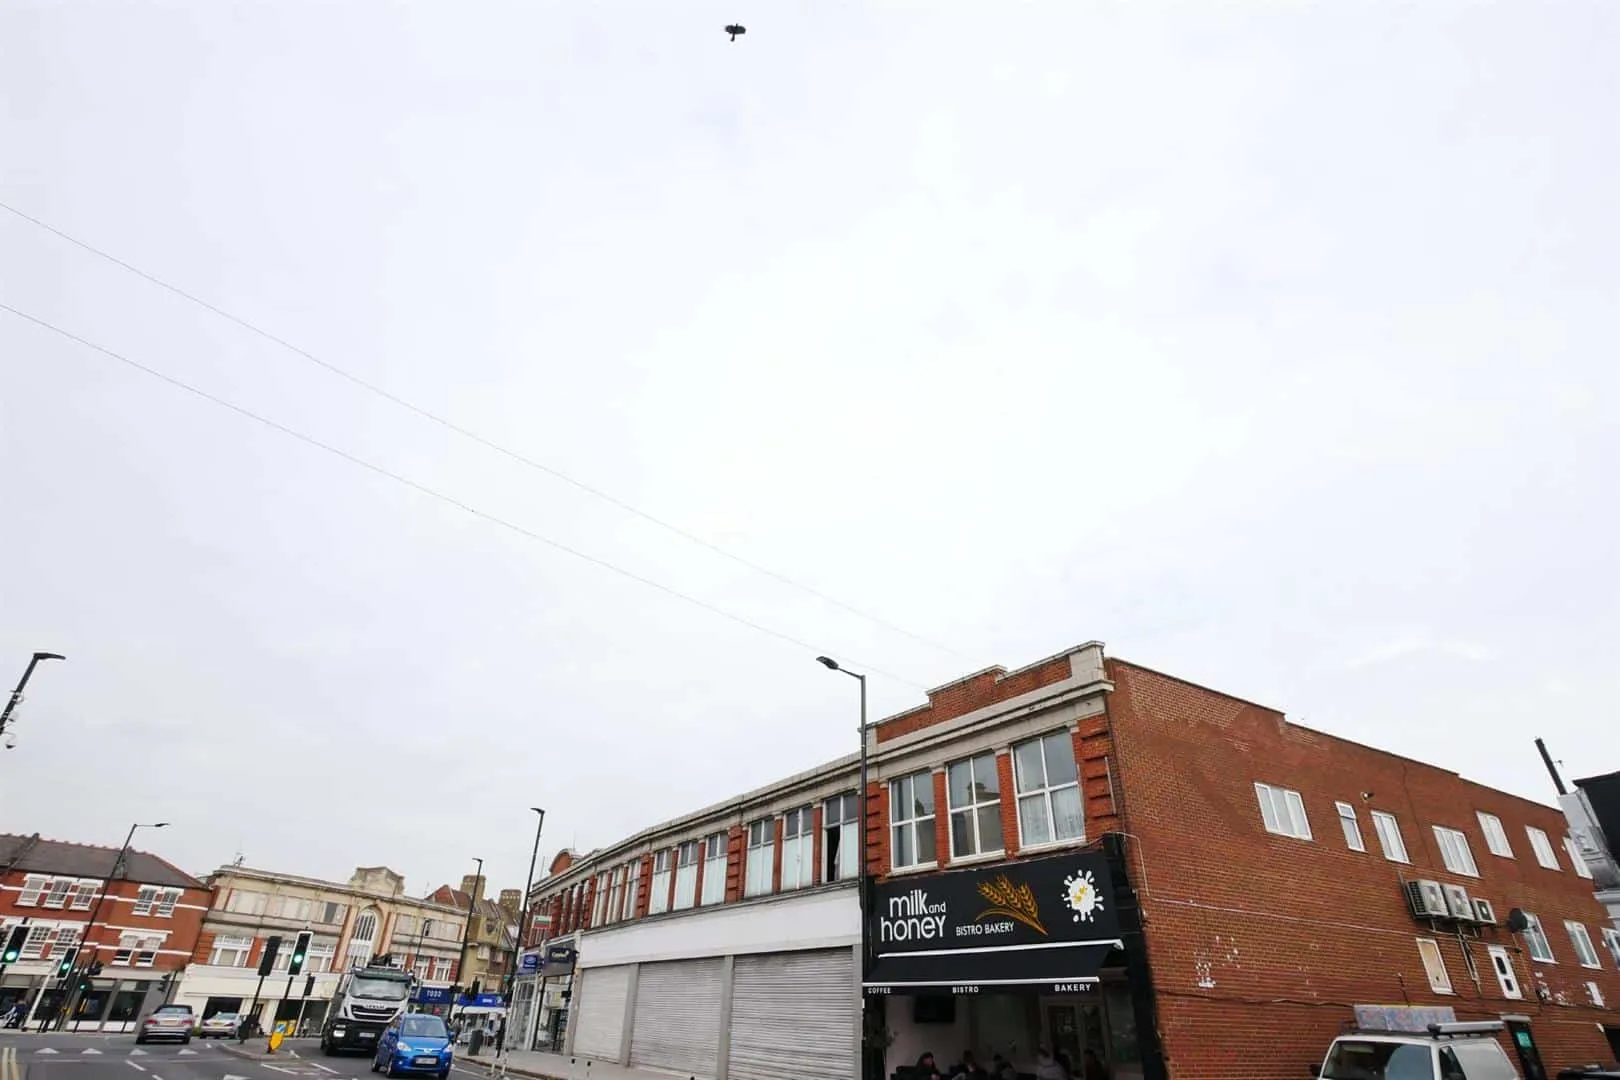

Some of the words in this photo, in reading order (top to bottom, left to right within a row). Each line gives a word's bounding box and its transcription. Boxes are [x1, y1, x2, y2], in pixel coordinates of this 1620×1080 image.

[889, 889, 928, 918] milk
[928, 901, 946, 913] and
[881, 914, 947, 941] honey
[956, 923, 983, 937] BISTRO
[984, 921, 1015, 935] BAKERY
[867, 987, 892, 995] COFFEE
[952, 985, 979, 994] BISTRO
[1054, 983, 1091, 992] BAKERY
